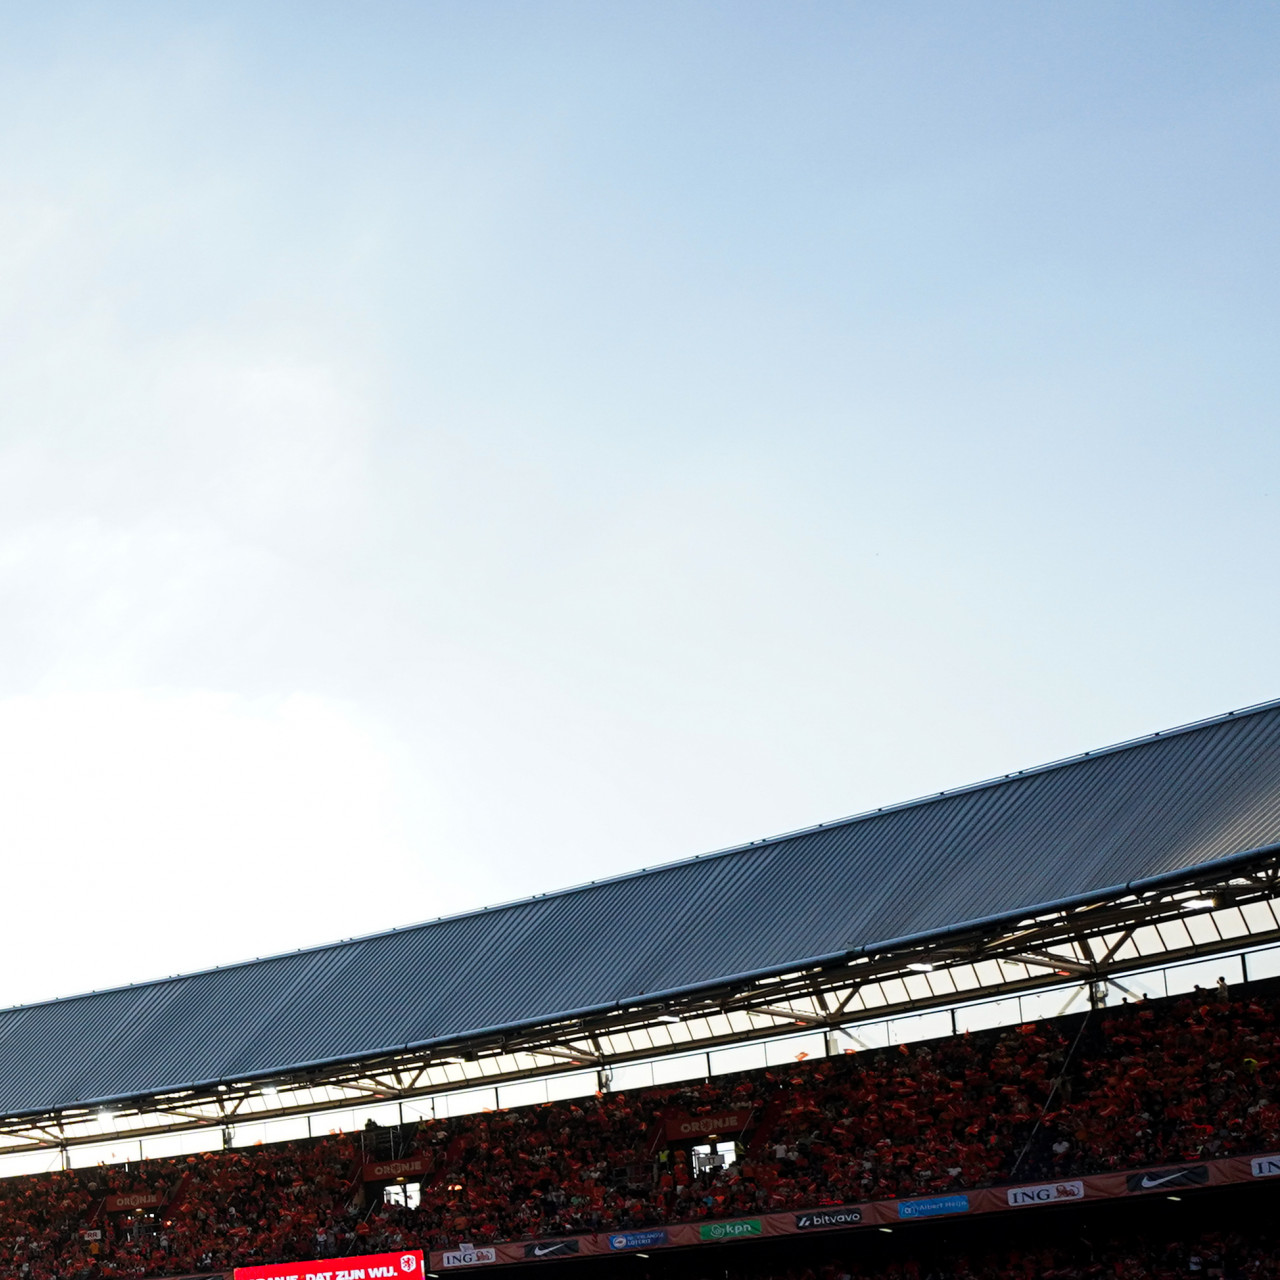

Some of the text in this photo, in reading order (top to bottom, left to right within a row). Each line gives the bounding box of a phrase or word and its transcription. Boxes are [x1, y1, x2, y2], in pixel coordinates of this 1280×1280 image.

[1257, 1162, 1280, 1174] IN
[1012, 1191, 1050, 1203] ING
[813, 1212, 860, 1225] bitvavo
[726, 1223, 751, 1235] kpn
[446, 1254, 472, 1265] ING
[368, 1266, 398, 1279] WIJ.
